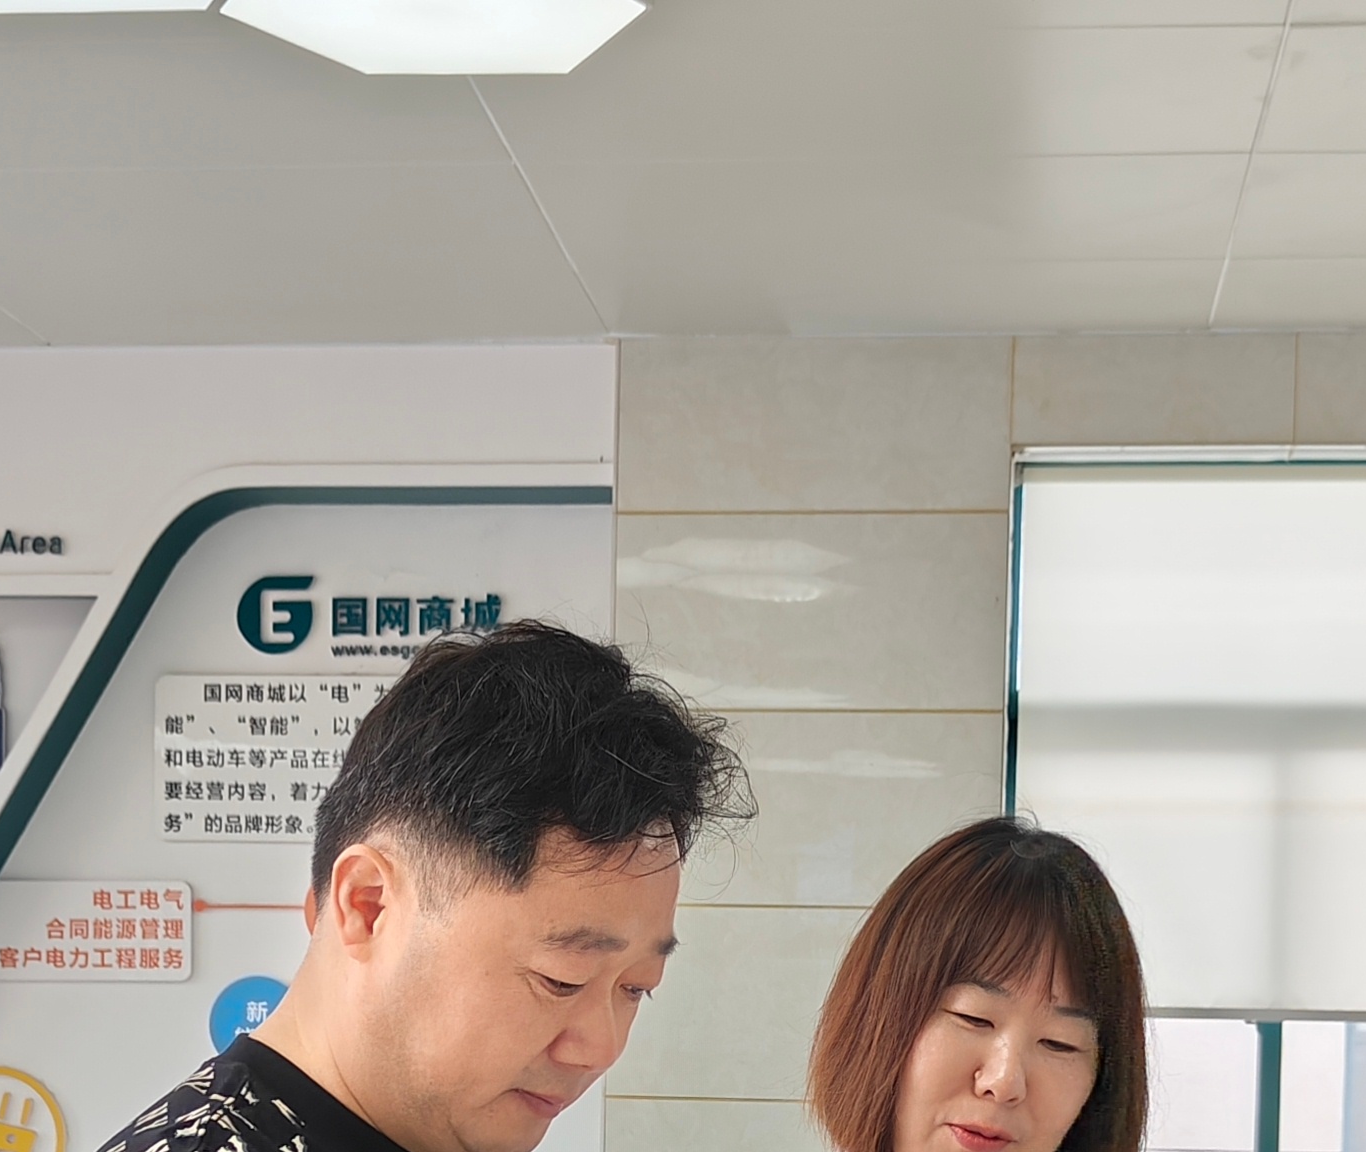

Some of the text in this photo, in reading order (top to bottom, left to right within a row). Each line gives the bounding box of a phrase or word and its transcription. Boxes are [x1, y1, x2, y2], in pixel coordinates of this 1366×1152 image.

[331, 593, 502, 636] 国网商城
[164, 814, 316, 835] 务”的品牌形象。
[93, 889, 185, 911] 电工电气
[45, 918, 185, 941] 合同能源管理
